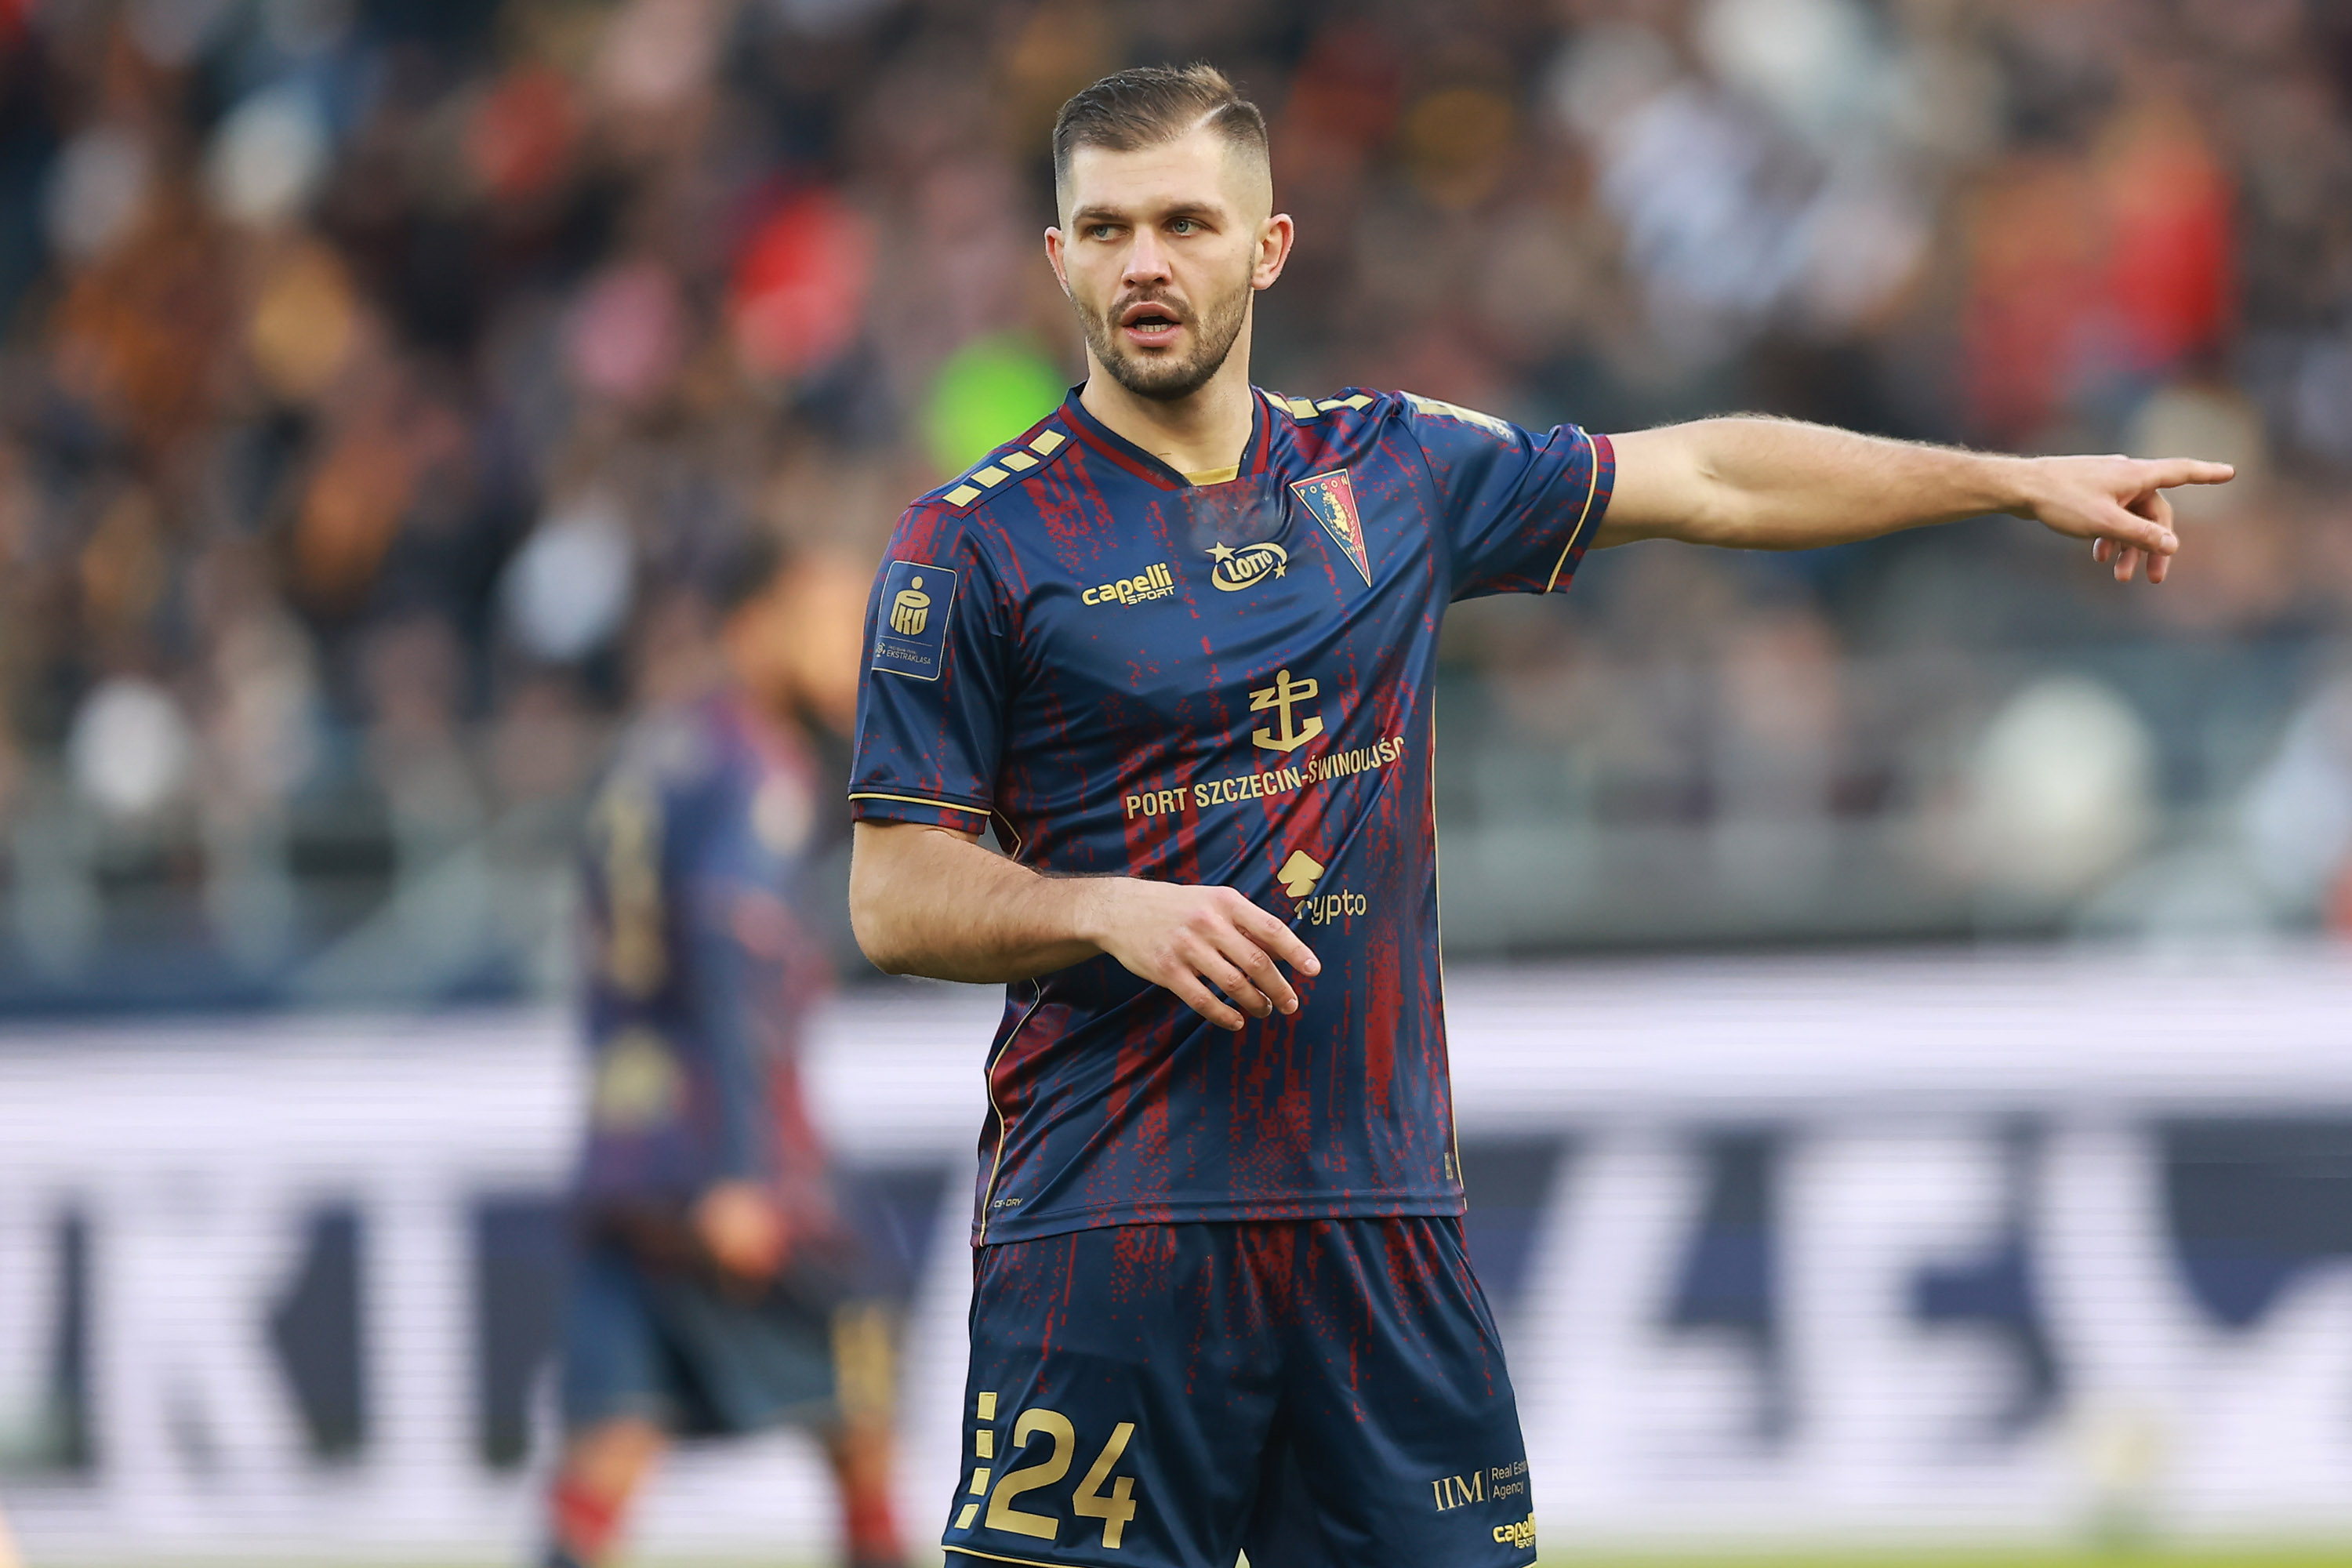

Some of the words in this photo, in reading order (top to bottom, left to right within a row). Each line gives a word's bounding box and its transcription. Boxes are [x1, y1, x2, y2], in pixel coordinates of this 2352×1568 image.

[1224, 550, 1273, 582] LOTTO
[1082, 563, 1173, 606] capelli
[1127, 586, 1174, 605] SPORT
[886, 649, 931, 665] EKSTRAKLASA
[1127, 787, 1188, 820] PORT
[984, 1408, 1136, 1549] 24
[1491, 1463, 1513, 1481] Real
[1493, 1480, 1524, 1500] Agency
